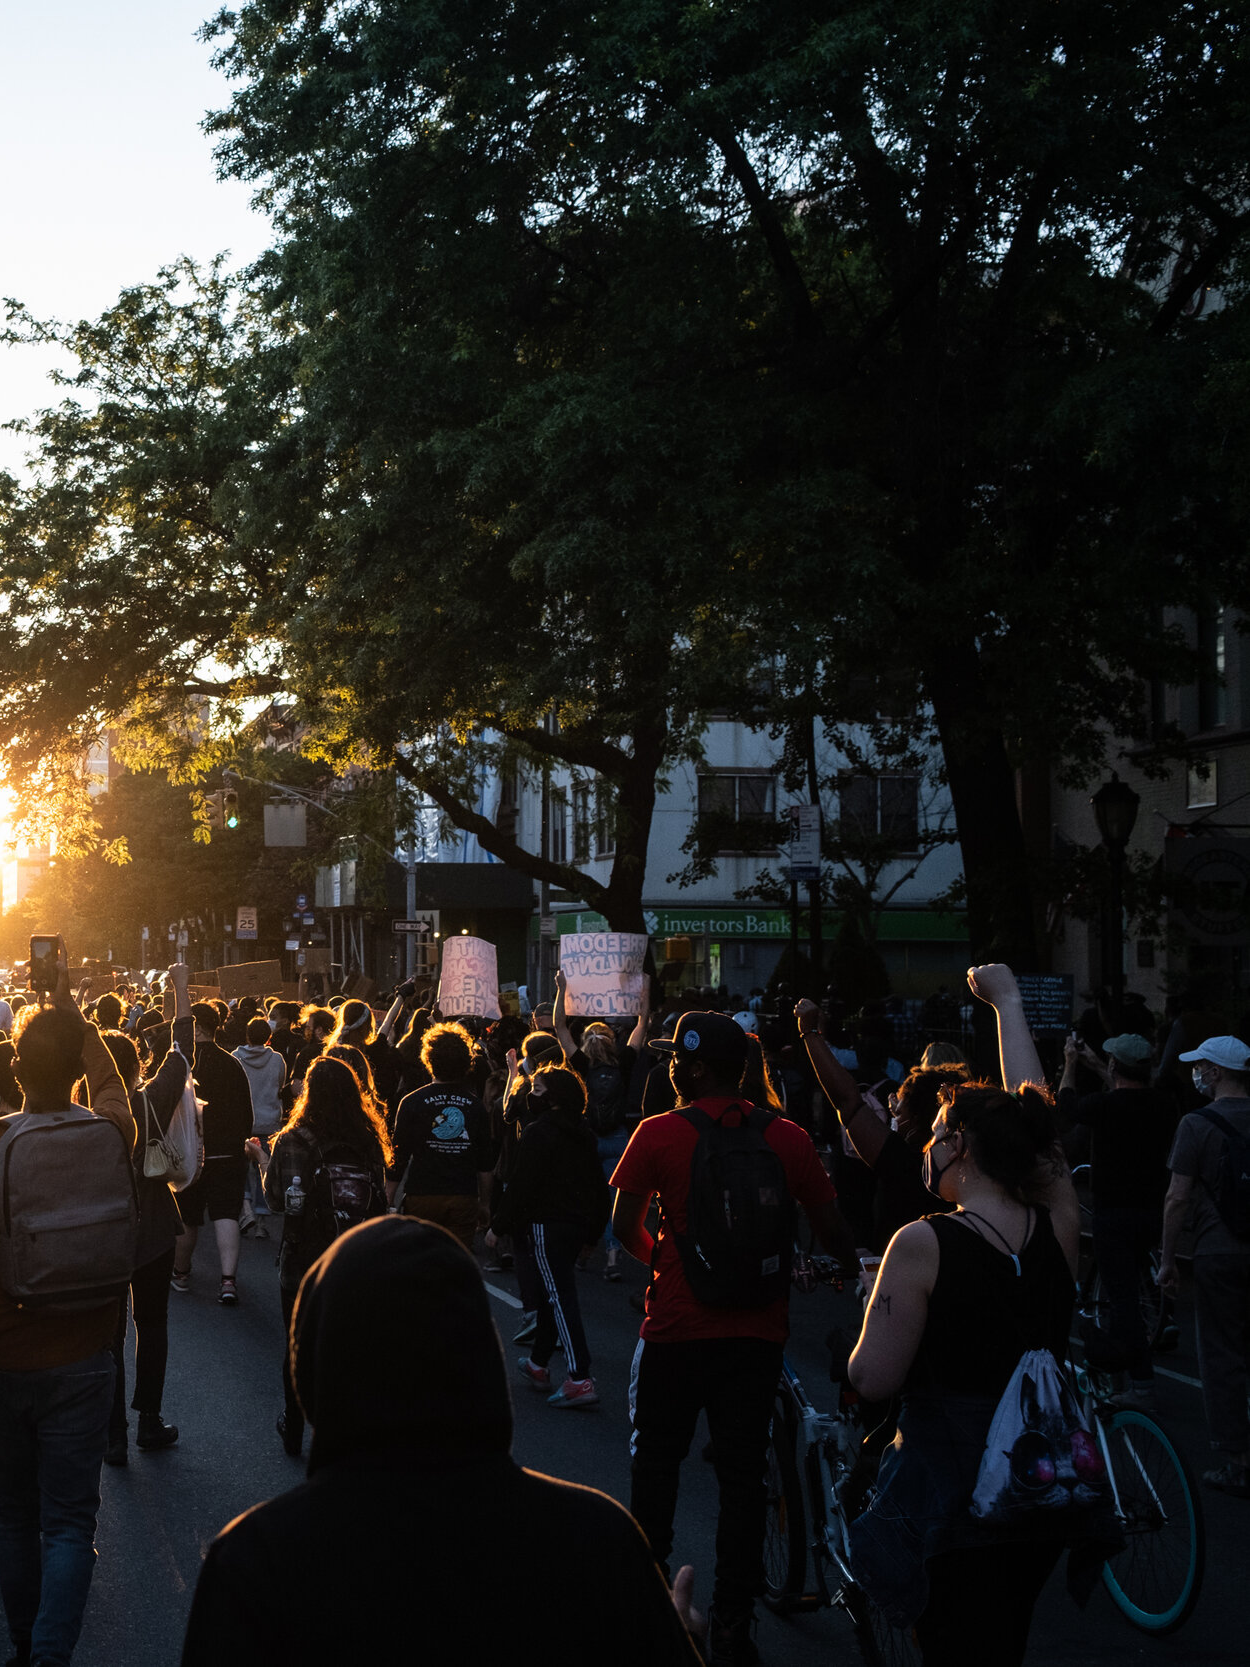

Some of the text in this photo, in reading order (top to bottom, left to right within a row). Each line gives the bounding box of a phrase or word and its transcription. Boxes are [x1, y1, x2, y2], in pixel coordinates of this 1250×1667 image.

[240, 919, 255, 929] 25
[424, 1094, 473, 1105] SALTY CREW
